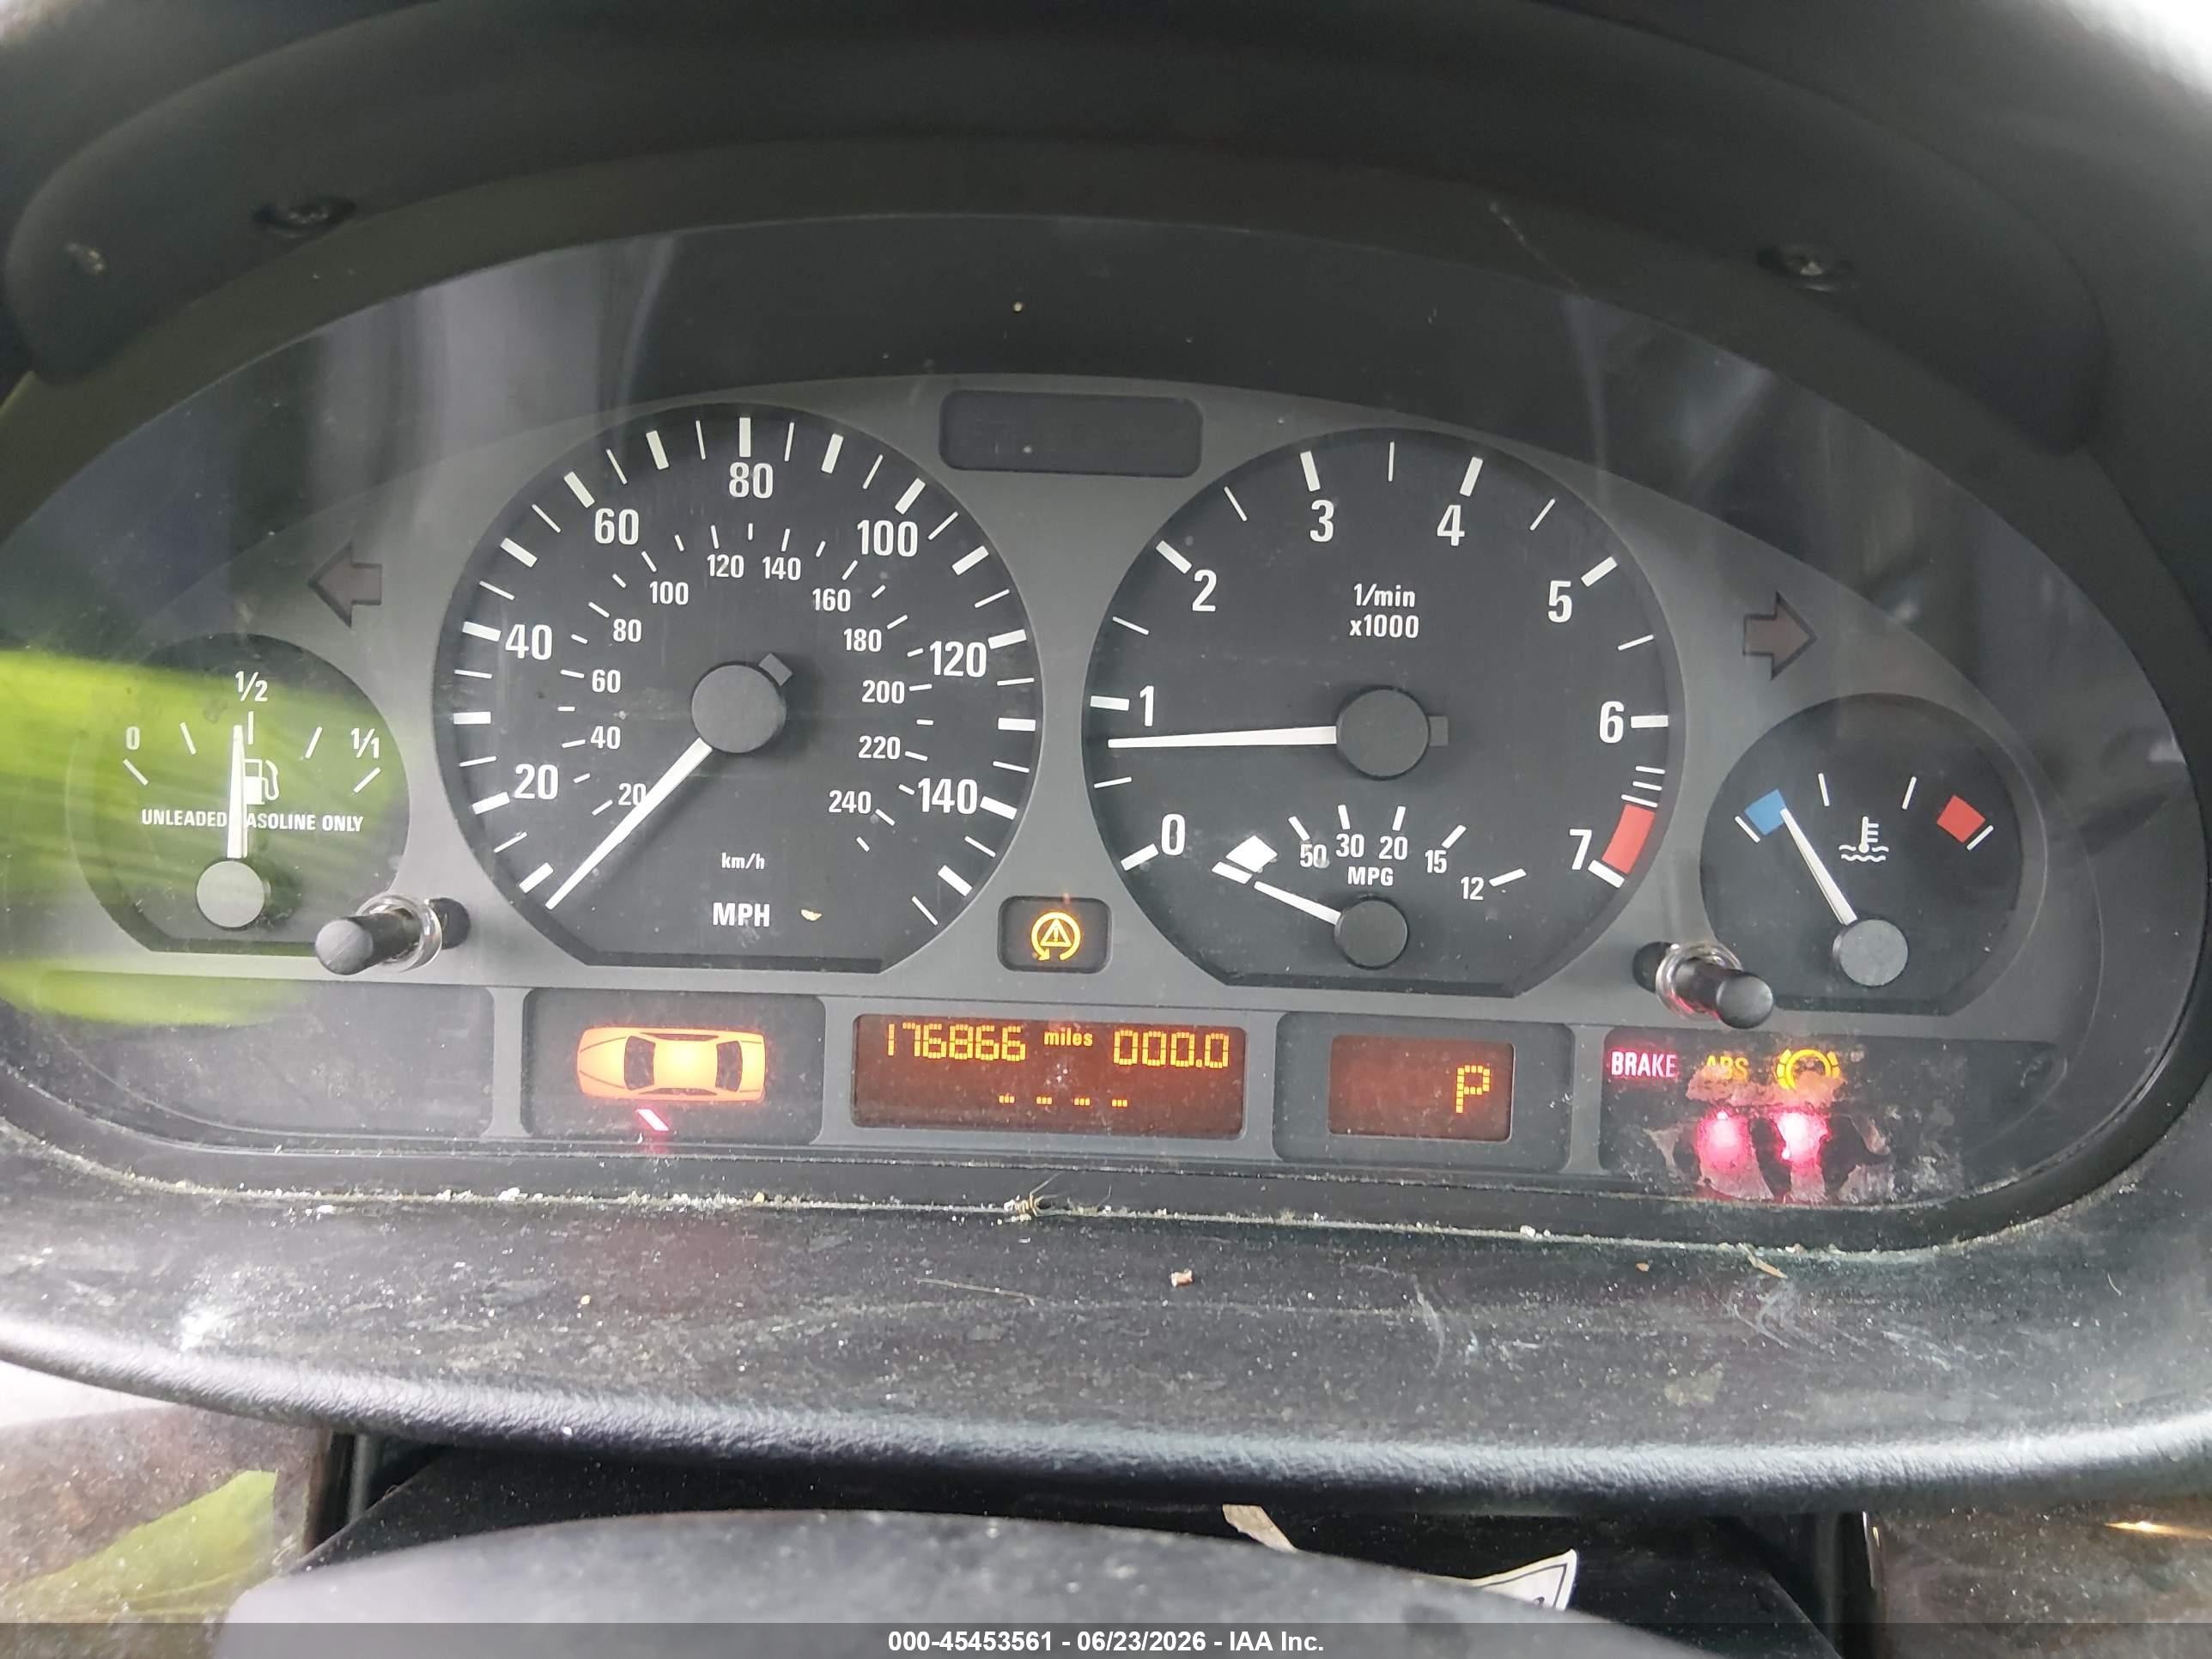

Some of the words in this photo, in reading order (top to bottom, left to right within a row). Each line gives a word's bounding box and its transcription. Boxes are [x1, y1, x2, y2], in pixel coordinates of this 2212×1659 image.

[729, 462, 773, 499] 80
[594, 507, 640, 545] 60
[1310, 499, 1334, 542] 3
[1437, 504, 1465, 546] 4
[857, 520, 918, 557] 100
[708, 555, 744, 578] 120
[763, 556, 801, 580] 140
[649, 581, 689, 605] 100
[811, 588, 851, 611] 160
[1192, 569, 1217, 611] 2
[1353, 583, 1415, 607] 1/min
[1547, 580, 1572, 623] 5
[613, 618, 641, 642] 80
[1349, 614, 1419, 639] x1000
[505, 623, 552, 659] 40
[843, 628, 882, 652] 180
[929, 641, 987, 678] 120
[592, 669, 621, 693] 60
[861, 679, 905, 704] 200
[1139, 685, 1154, 726] 1
[1599, 701, 1625, 744] 6
[125, 726, 140, 750] 0
[590, 726, 621, 750] 40
[859, 735, 901, 760] 220
[514, 763, 559, 800] 20
[617, 783, 647, 806] 20
[829, 790, 872, 814] 240
[917, 778, 978, 814] 140
[142, 808, 227, 828] UNLEADED
[246, 812, 316, 831] ASOLINE
[322, 816, 363, 832] ONLY
[1161, 814, 1186, 856] 0
[1335, 833, 1364, 858] 30
[1299, 844, 1327, 867] 50
[1379, 836, 1408, 860] 20
[1569, 829, 1592, 870] 7
[721, 853, 764, 871] km/h
[1425, 849, 1447, 873] 15
[1347, 866, 1394, 886] MPG
[1461, 876, 1484, 901] 12
[713, 902, 770, 927] MPH
[887, 1022, 1026, 1062] 176866
[1043, 1027, 1093, 1047] miles
[1113, 1030, 1230, 1069] 000.0
[1611, 1050, 1678, 1079] BRAKE
[1705, 1054, 1749, 1080] ABS
[1455, 1065, 1491, 1114] P
